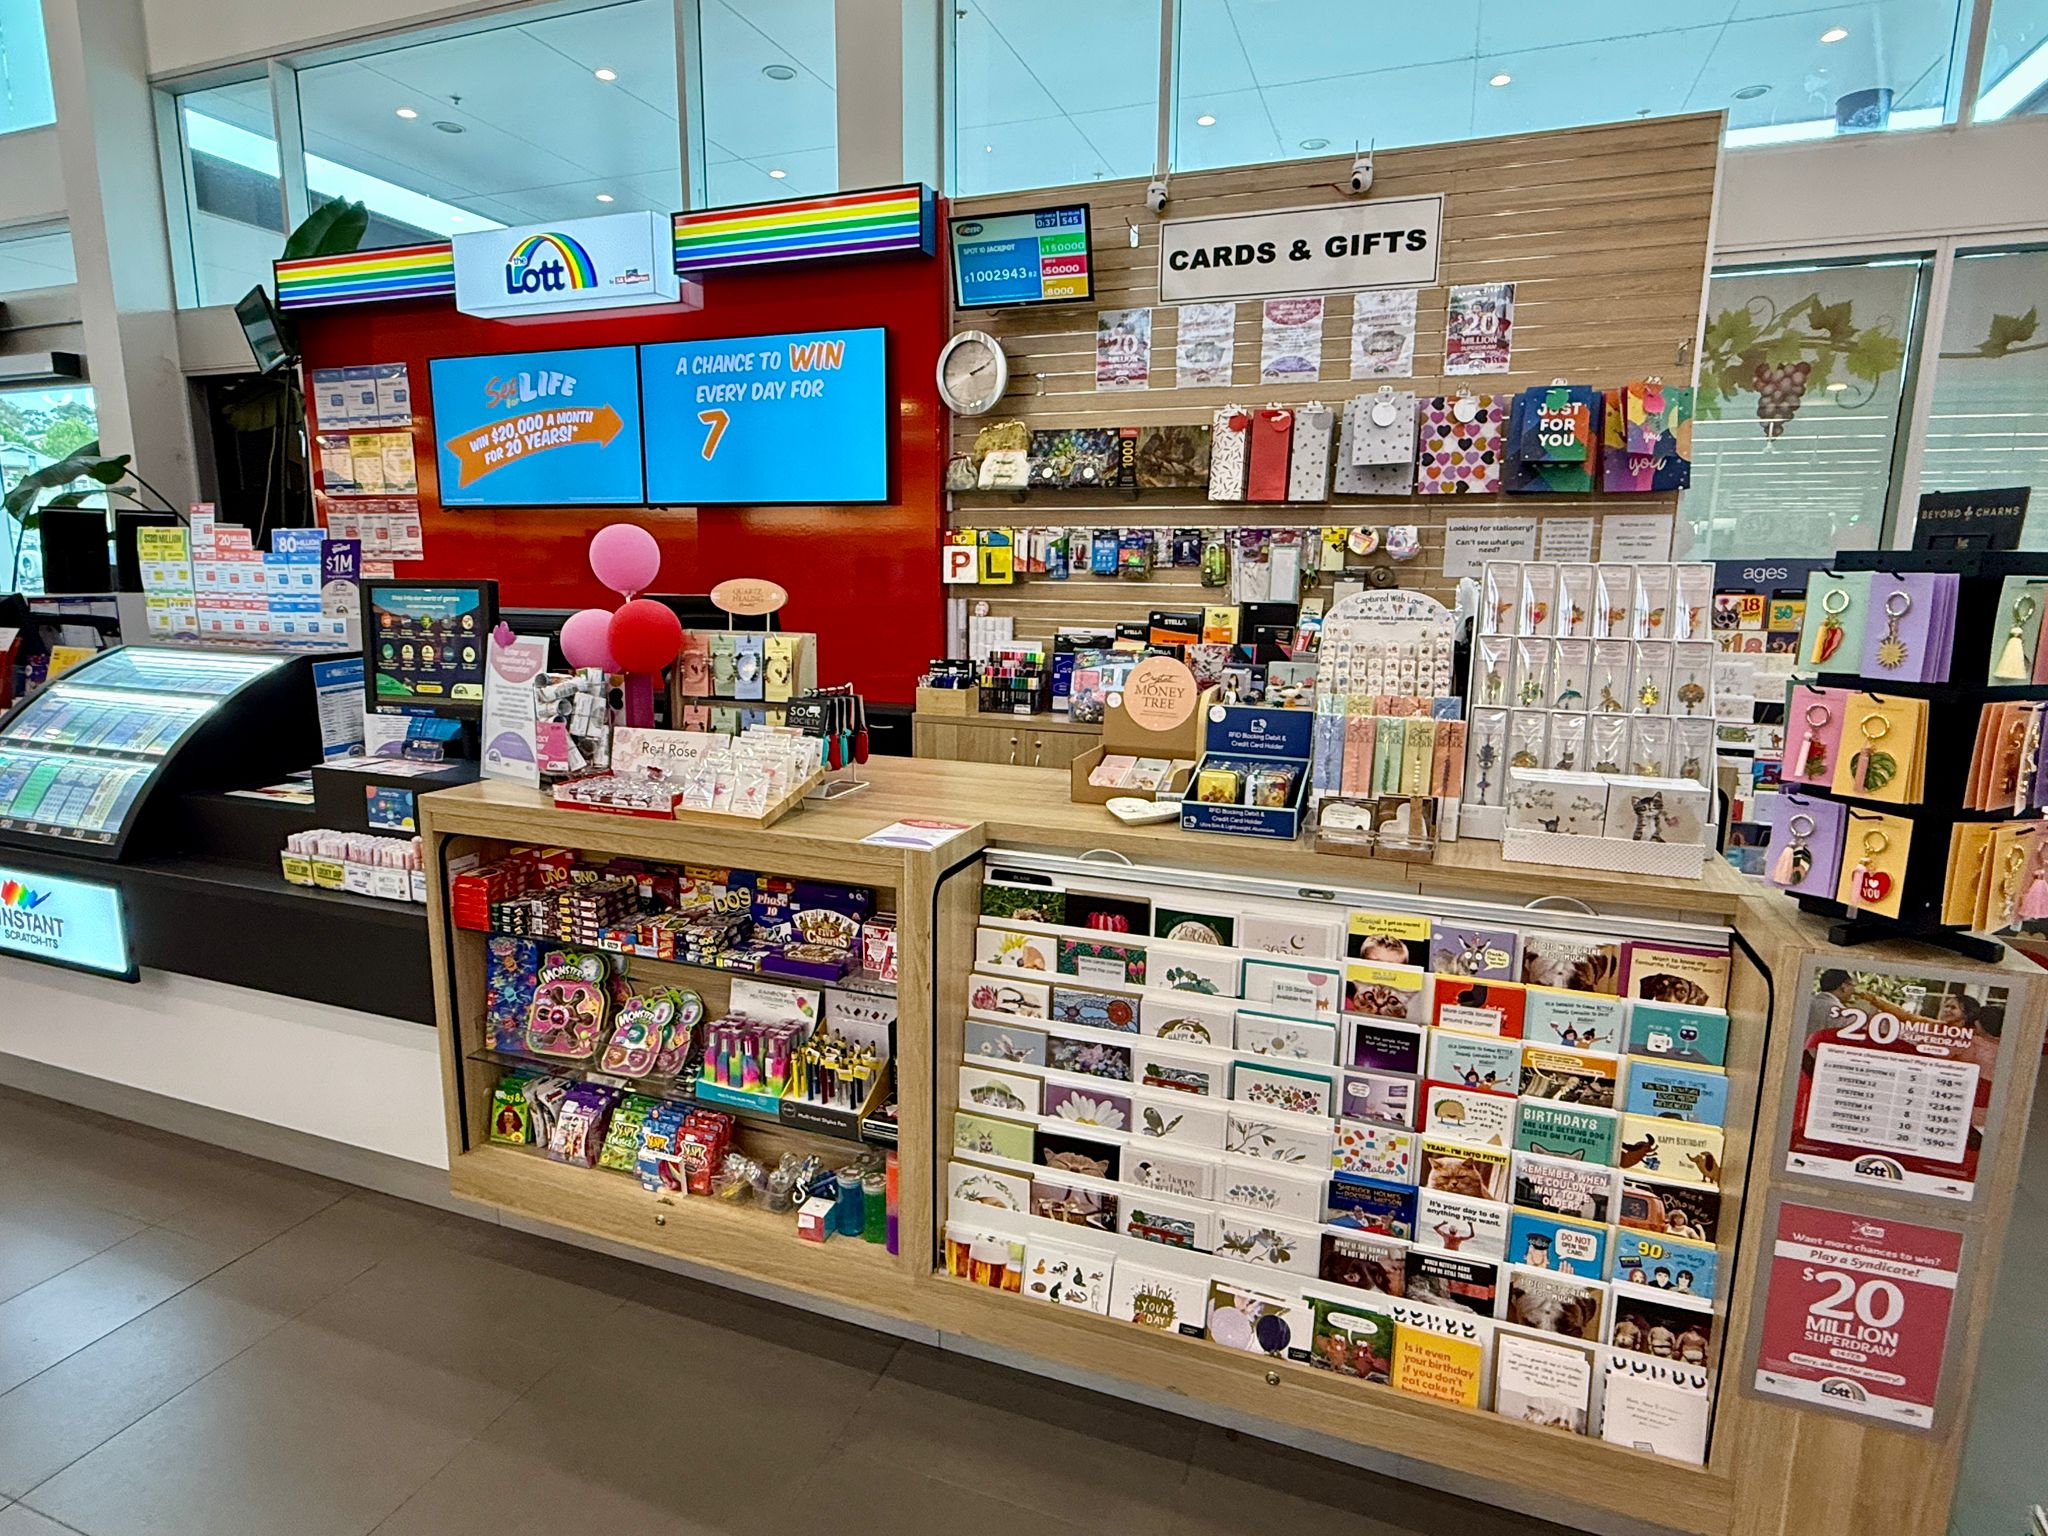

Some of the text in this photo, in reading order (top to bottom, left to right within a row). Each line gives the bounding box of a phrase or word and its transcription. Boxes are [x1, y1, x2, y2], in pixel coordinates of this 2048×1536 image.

[1062, 216, 1079, 225] 545
[986, 243, 1016, 254] JACKPOT
[1169, 228, 1428, 272] CARDS & GIFTS
[505, 260, 566, 295] Lott
[1461, 335, 1498, 346] MILLION
[675, 340, 846, 376] A CHANCE TO WIN
[519, 371, 578, 403] LIFE
[695, 379, 824, 404] EVERY DAY FOR
[1540, 418, 1576, 431] FOR
[699, 408, 730, 461] 7
[1537, 433, 1575, 447] YOU
[484, 448, 505, 465] FOR
[504, 440, 522, 458] 20
[1122, 440, 1135, 469] 1000
[1448, 524, 1534, 533] Looking for stationery?
[1478, 546, 1501, 554] need?
[326, 554, 353, 573] $1M
[951, 551, 971, 579] P
[985, 552, 1006, 579] L
[1743, 566, 1788, 583] ages
[1355, 593, 1424, 606] Captured With Love
[1741, 597, 1760, 613] 18
[1164, 618, 1188, 626] STELLA
[1134, 684, 1186, 698] MONEY
[1142, 697, 1175, 710] TREE
[788, 716, 821, 726] SOCIETY
[641, 741, 698, 758] Red Rose
[1231, 739, 1249, 747] Credit
[1265, 742, 1284, 750] Holder
[1211, 815, 1264, 825] Credit Card Holder
[540, 867, 568, 885] UNO
[714, 887, 752, 913] DOS
[756, 893, 788, 907] Phase
[1863, 887, 1881, 899] YOU
[766, 906, 778, 916] 10
[4, 929, 59, 949] SCRATCH-ITS
[806, 931, 849, 949] CROWNS
[817, 927, 835, 938] FIVE
[542, 965, 584, 984] MONSTER
[845, 992, 880, 1004] Stylus Pen
[1829, 1006, 1974, 1045] $20 MILLION
[1903, 1031, 1972, 1049] SUPERDRAW
[1836, 1088, 1864, 1098] SYSTEM
[1838, 1076, 1866, 1086] SYSTEM
[1908, 1087, 1915, 1095] 6
[1834, 1099, 1862, 1110] SYSTEM
[1904, 1110, 1911, 1118] 8
[1523, 1108, 1598, 1131] BIRTHDAYS
[1832, 1111, 1911, 1131] SYSTEM 15 10
[1539, 1123, 1554, 1131] LIKE
[1555, 1126, 1588, 1137] GETTING
[1589, 1131, 1605, 1140] DOG
[1830, 1122, 1858, 1133] SYSTEM
[1896, 1133, 1909, 1142] 20
[1657, 1135, 1708, 1148] HAPPY BIRTHDAY!
[1426, 1143, 1508, 1164] YEAH I'M INTO FITBIT
[1521, 1163, 1608, 1186] REMEMBER WHEN
[1855, 1163, 1888, 1178] Lott
[1337, 1182, 1402, 1201] SHERLOCK HOLMES
[1528, 1175, 1595, 1193] WE COULDN'T
[1533, 1184, 1590, 1203] WAIT TO BE
[1429, 1199, 1441, 1208] It's
[1443, 1202, 1461, 1212] your
[1462, 1206, 1477, 1216] day
[1489, 1211, 1500, 1219] do
[1542, 1195, 1582, 1211] OLDER?
[1426, 1207, 1501, 1227] anything you want.
[1334, 1239, 1351, 1248] WHAT
[1357, 1243, 1368, 1251] THE
[1368, 1245, 1389, 1256] HUMAN
[1561, 1232, 1592, 1246] DO NOT
[1561, 1241, 1590, 1252] OPEN THIS
[1792, 1231, 1941, 1266] Want more chances to win?
[1424, 1258, 1471, 1272] WHEN NETFLIX ASKS
[1426, 1266, 1444, 1275] YOU'RE
[1444, 1269, 1457, 1278] STILL
[1809, 1249, 1921, 1278] Play a Syndicate!
[1141, 1284, 1172, 1300] ENJOY
[1802, 1267, 1905, 1328] $20
[1141, 1300, 1169, 1315] YOUR
[1145, 1315, 1166, 1326] DAY
[1805, 1315, 1899, 1348] MILLION
[1404, 1342, 1452, 1363] Is it even
[1804, 1330, 1896, 1357] SUPERDRAW
[1402, 1365, 1464, 1387] if you don't
[1403, 1354, 1475, 1380] your birthday
[1401, 1375, 1467, 1399] eat cake for
[1821, 1383, 1851, 1399] Lott
